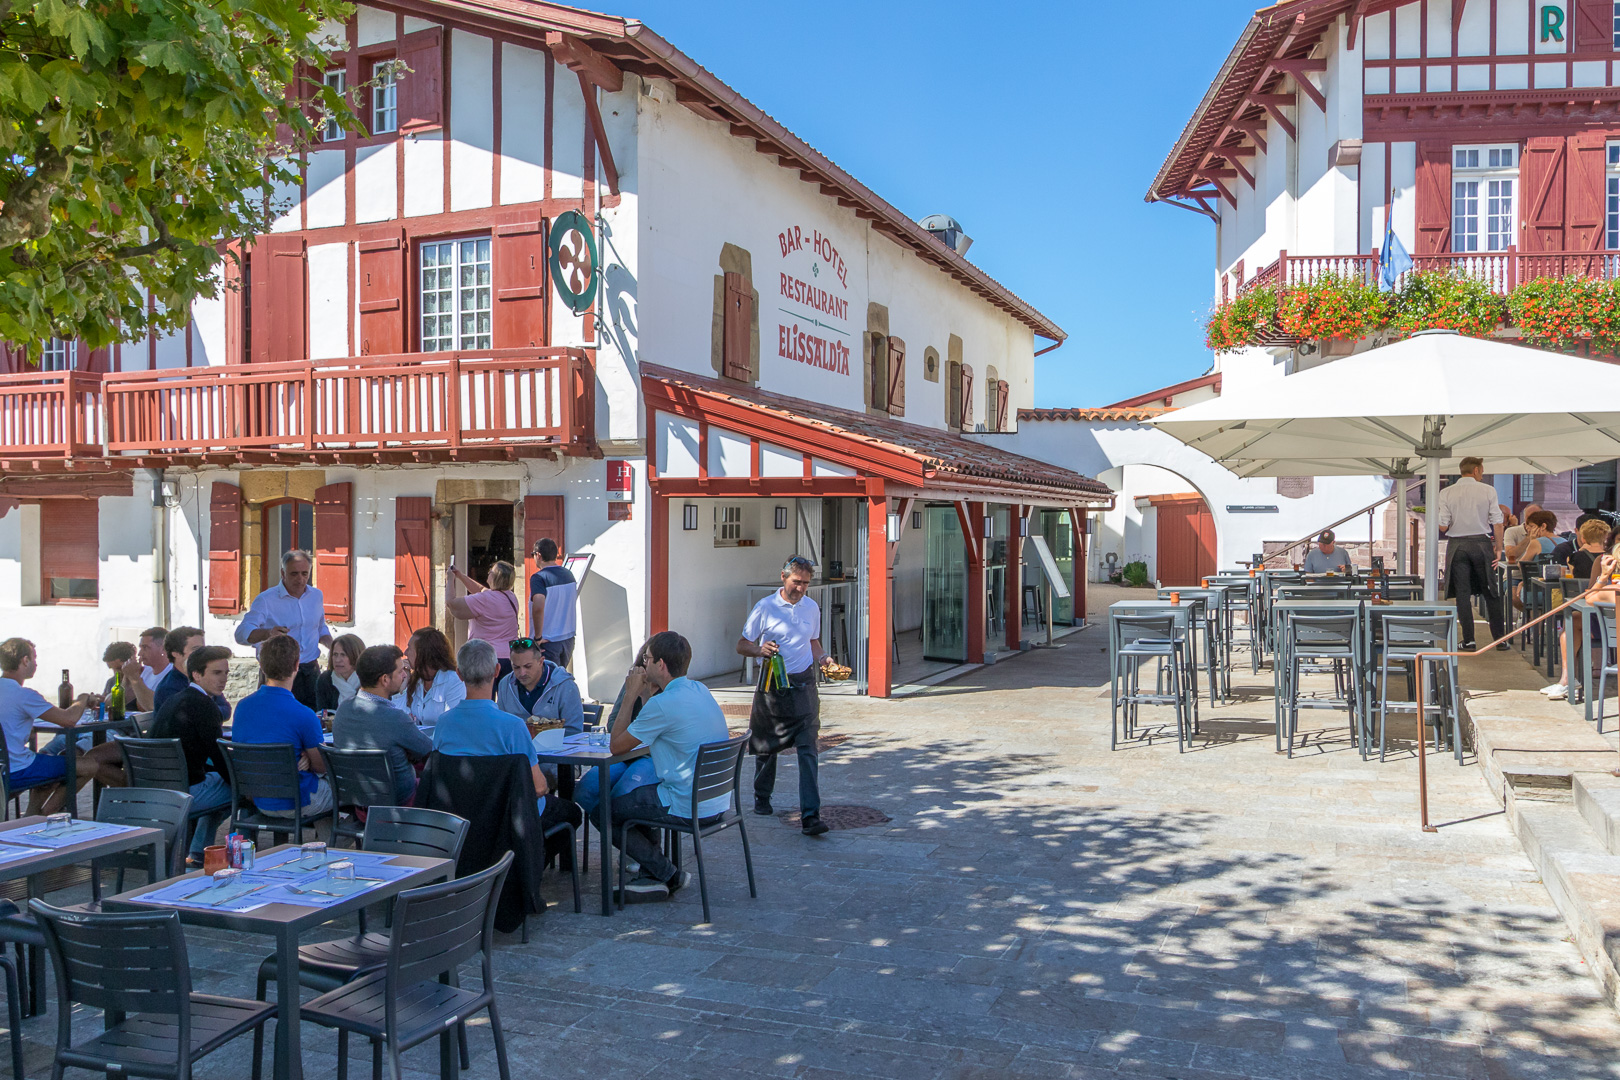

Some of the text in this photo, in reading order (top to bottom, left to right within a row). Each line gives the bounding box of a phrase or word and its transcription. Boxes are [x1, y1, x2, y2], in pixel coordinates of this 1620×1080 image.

[1541, 5, 1564, 42] R
[778, 225, 802, 258] BAR
[814, 229, 848, 290] HOTEL
[780, 272, 848, 321] RESTAURANT
[617, 466, 630, 477] H
